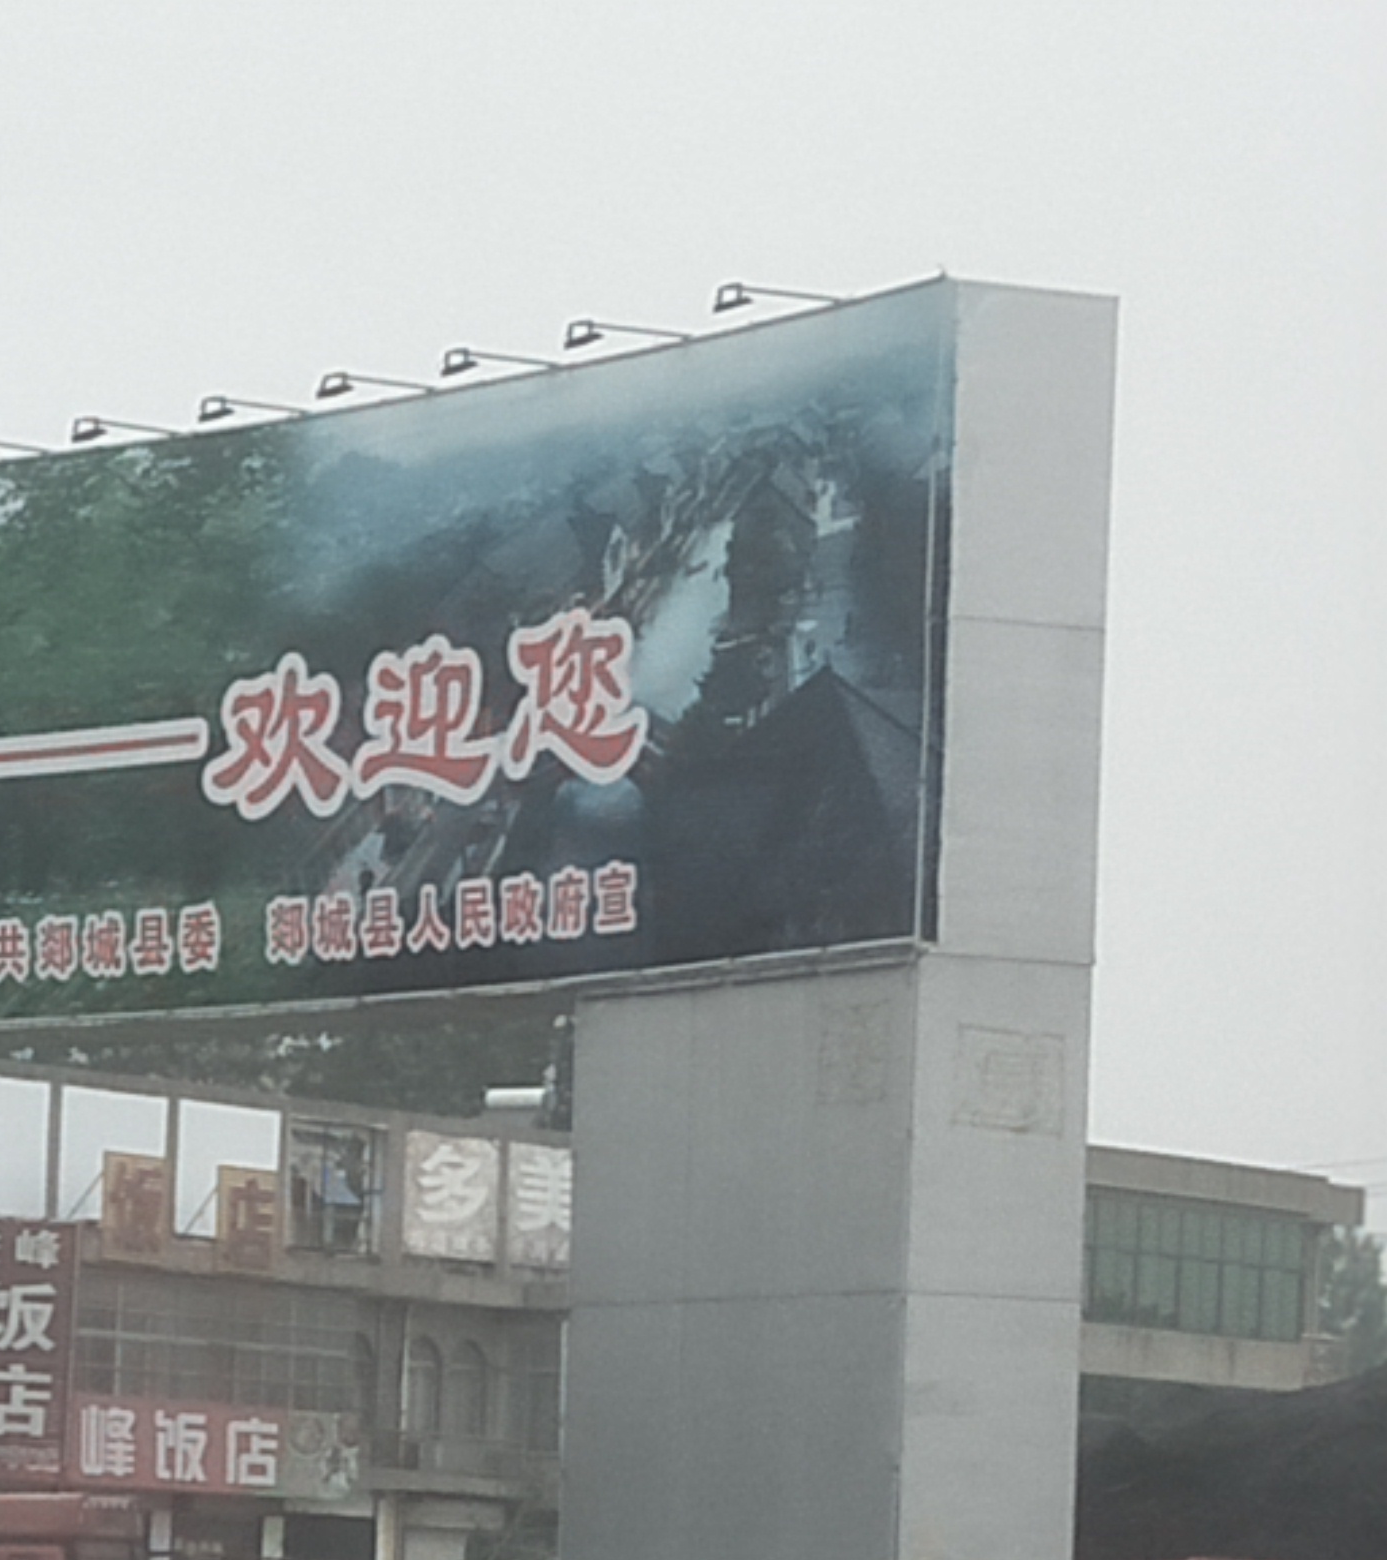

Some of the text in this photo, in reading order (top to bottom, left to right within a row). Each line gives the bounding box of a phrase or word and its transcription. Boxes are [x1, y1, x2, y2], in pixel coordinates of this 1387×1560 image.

[265, 860, 637, 962] 郯城县人民政府宣
[80, 1404, 279, 1487] 峰饭店
